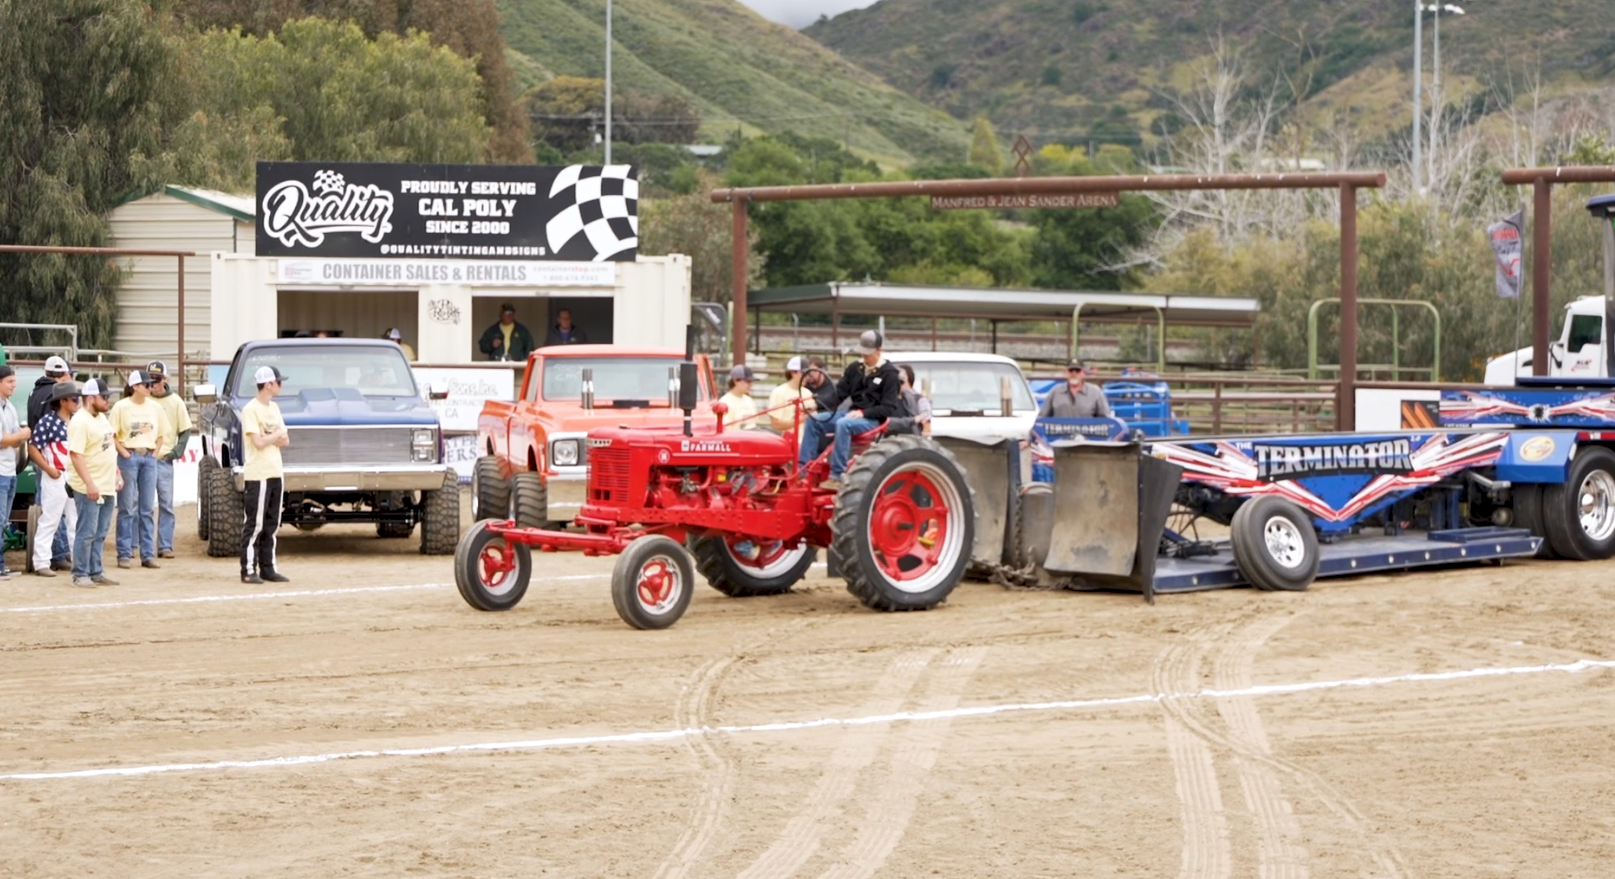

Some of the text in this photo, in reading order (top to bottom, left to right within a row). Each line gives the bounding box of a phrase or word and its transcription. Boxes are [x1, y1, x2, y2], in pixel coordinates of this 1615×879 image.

[401, 180, 536, 195] PROUDLY SERVING
[418, 198, 517, 217] CAL POLY
[932, 194, 1118, 208] MANFRED & JEAN SANDER ARENA
[262, 180, 394, 247] Quality
[425, 220, 510, 234] SINCE 2000
[322, 263, 401, 280] CONTAINER
[405, 264, 448, 281] SALES
[452, 267, 462, 281] &
[466, 264, 526, 282] RENTALS
[444, 407, 459, 419] CA
[1044, 423, 1109, 436] TERMINATOR
[690, 443, 731, 452] FARMALL
[1254, 439, 1412, 477] TERMINATOR
